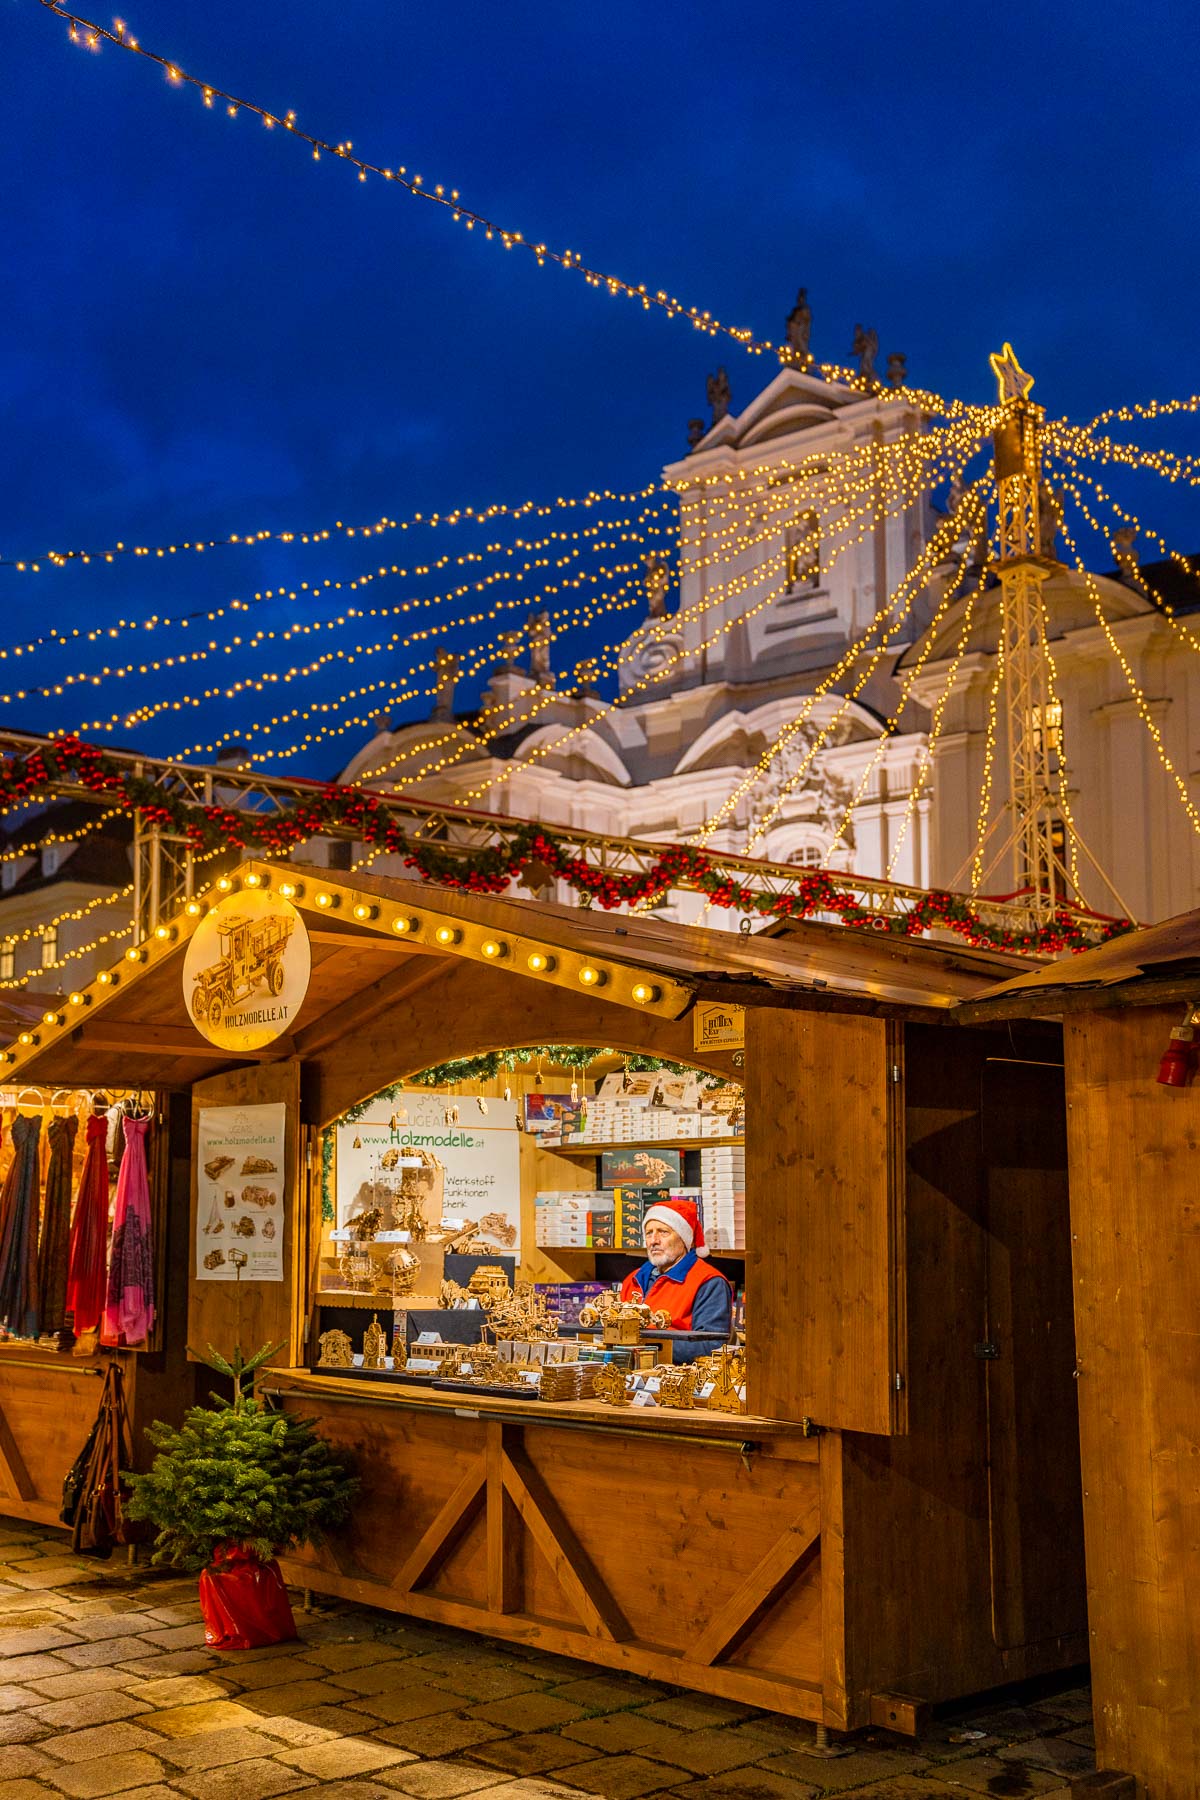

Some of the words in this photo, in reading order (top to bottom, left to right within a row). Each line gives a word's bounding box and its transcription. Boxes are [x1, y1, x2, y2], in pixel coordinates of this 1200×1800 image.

[225, 1005, 288, 1028] HOLZMODELLE.AT
[735, 1056, 745, 1066] 2
[207, 1136, 276, 1146] www.holzmodelle.at
[446, 1175, 495, 1186] Werkstoff
